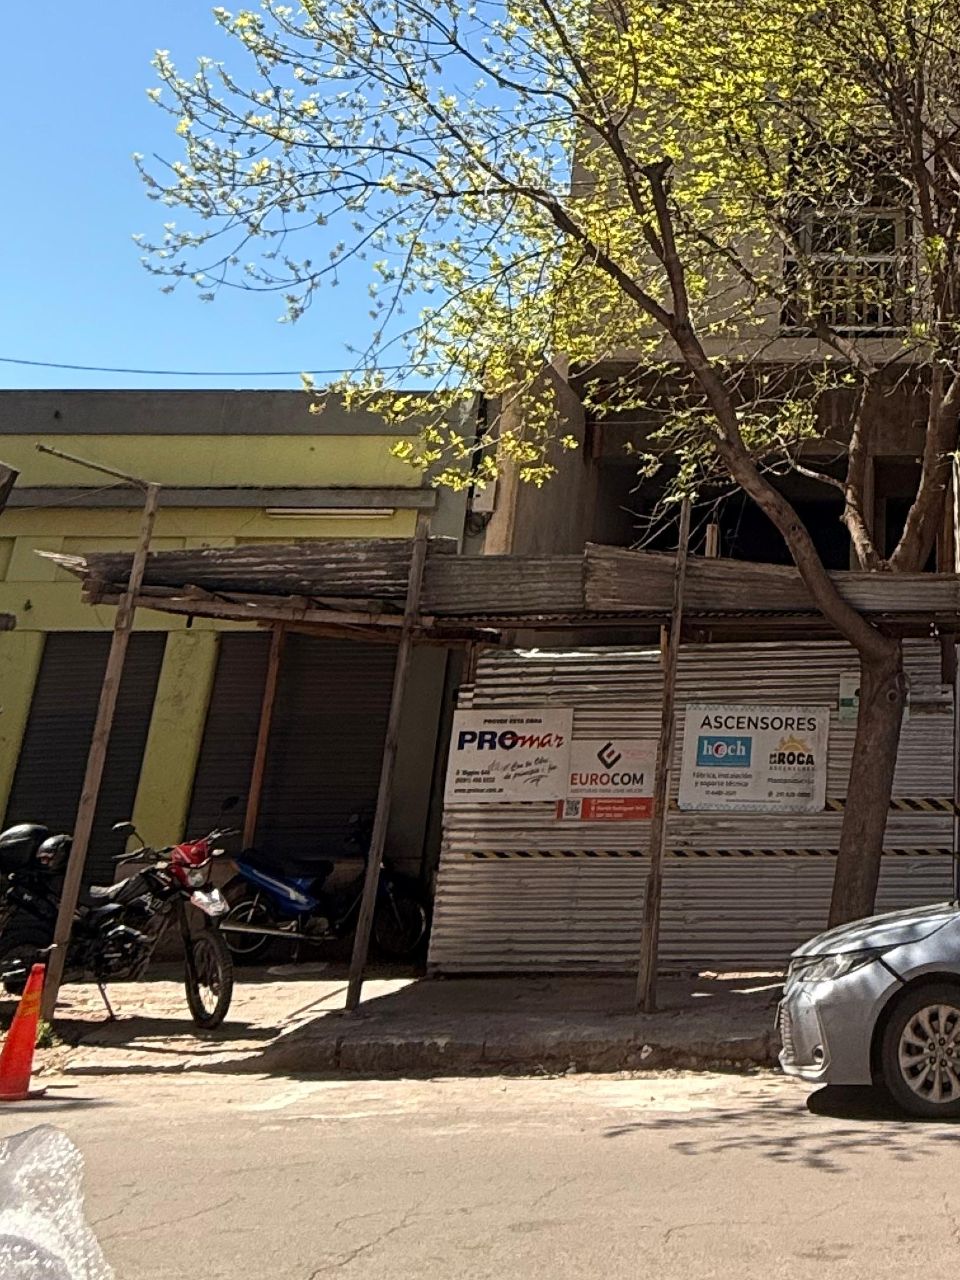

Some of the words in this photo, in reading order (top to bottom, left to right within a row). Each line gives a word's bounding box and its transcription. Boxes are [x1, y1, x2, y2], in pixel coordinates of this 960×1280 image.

[700, 714, 817, 732] ASCENSORES
[777, 751, 815, 766] ROCA
[570, 772, 644, 786] EUROCOM
